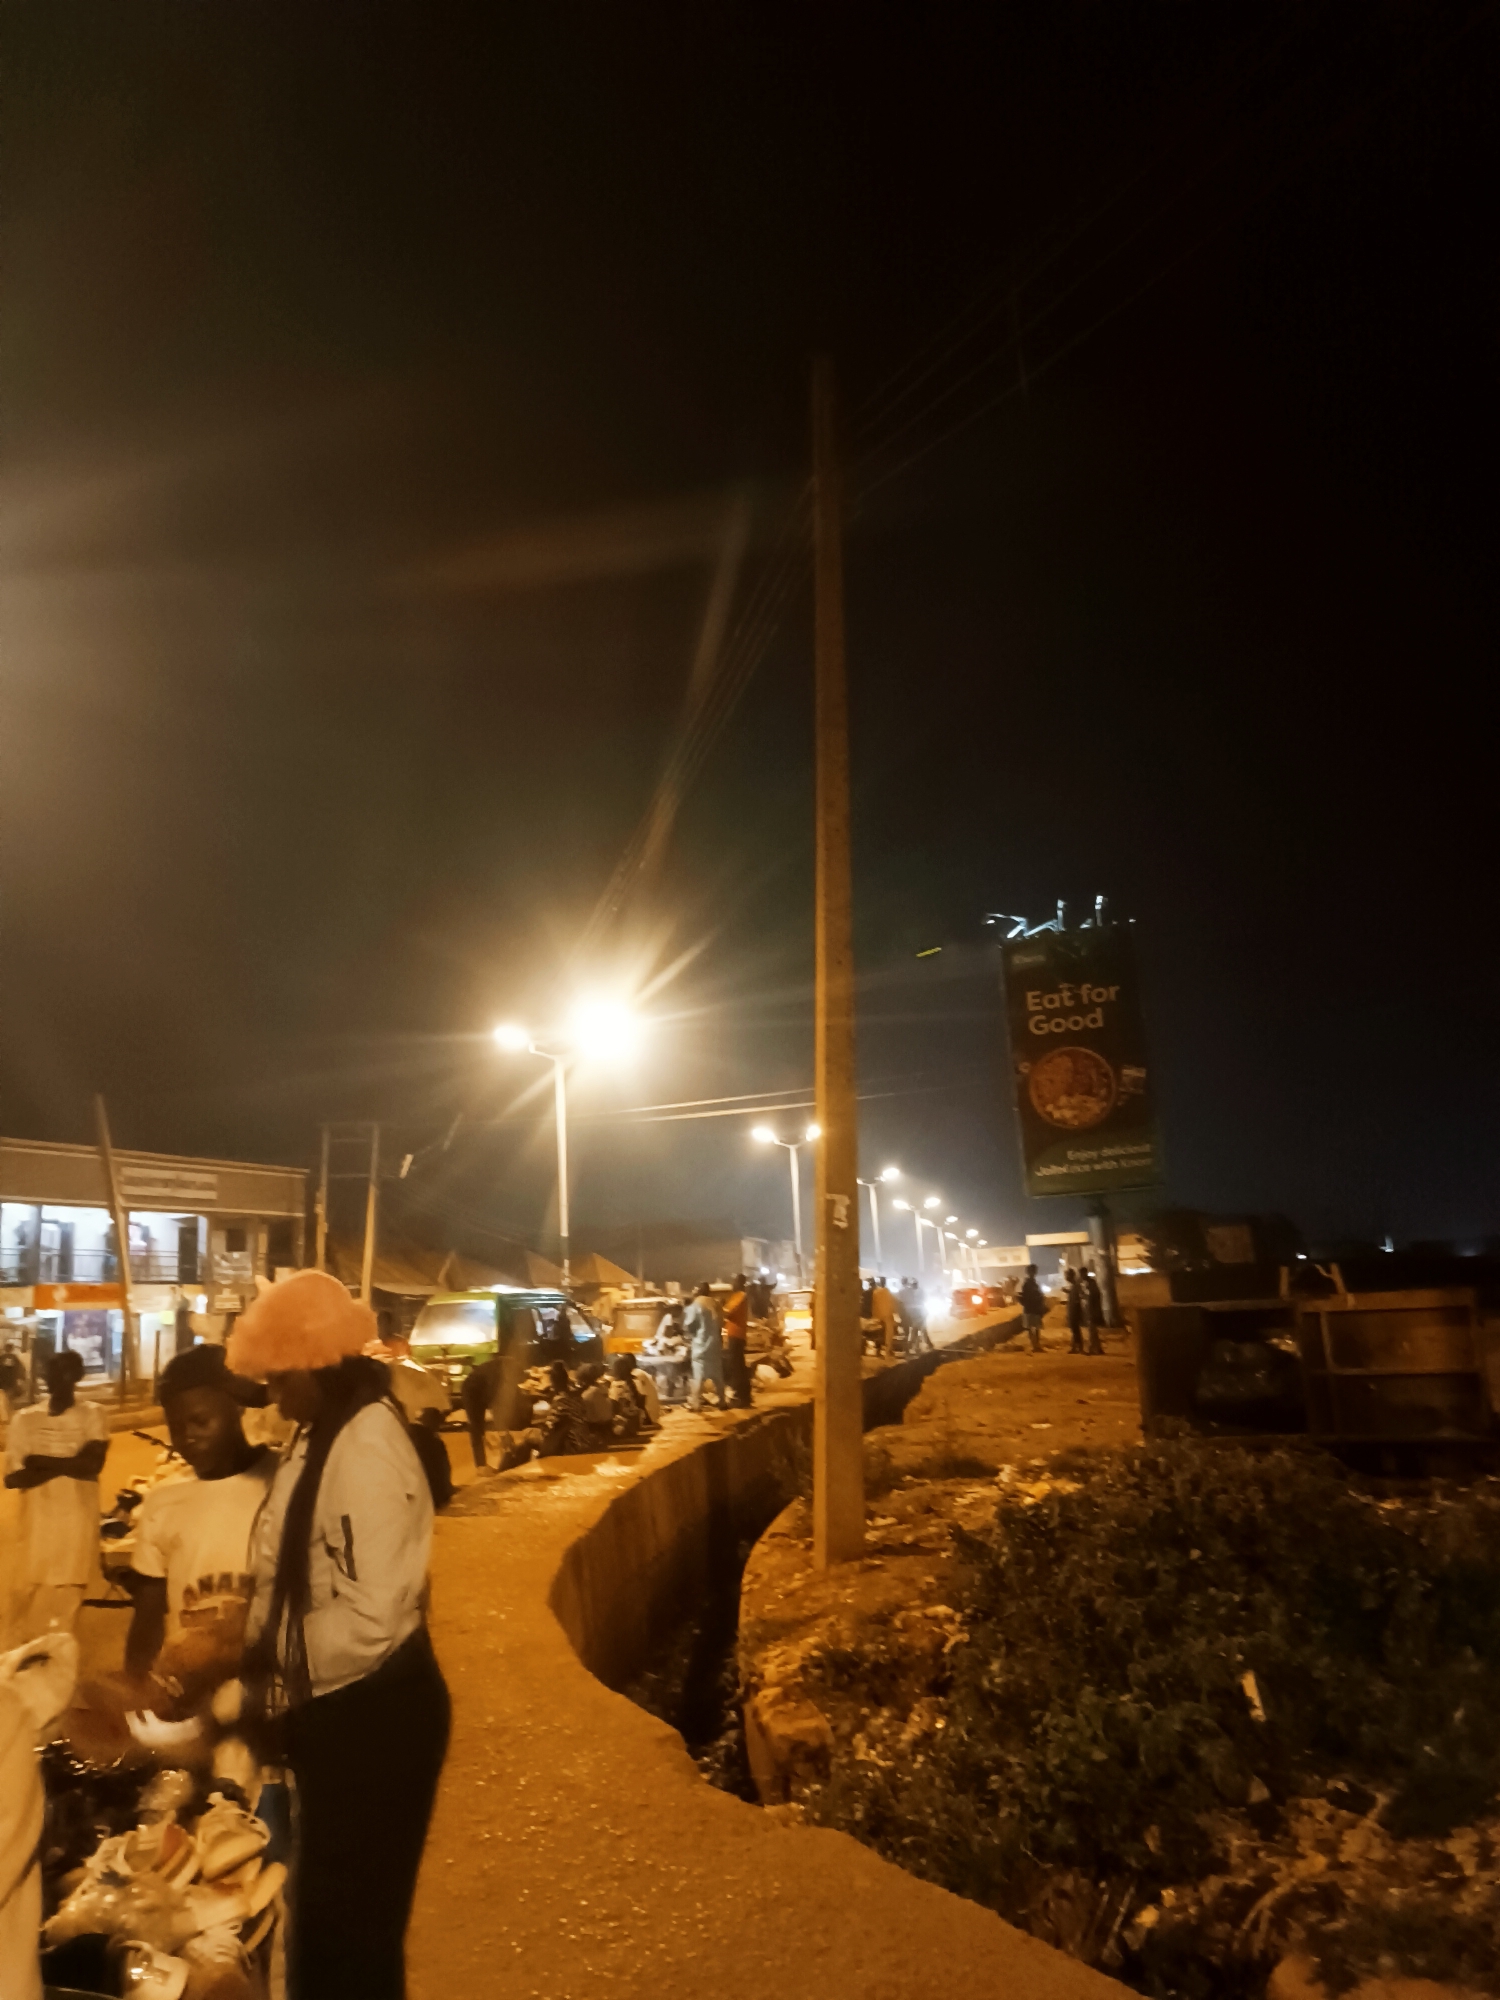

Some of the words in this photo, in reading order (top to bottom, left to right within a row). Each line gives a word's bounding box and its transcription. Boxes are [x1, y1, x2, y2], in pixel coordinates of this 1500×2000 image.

[1026, 984, 1075, 1011] Eat
[1080, 983, 1120, 1005] for
[1028, 1007, 1104, 1035] Good
